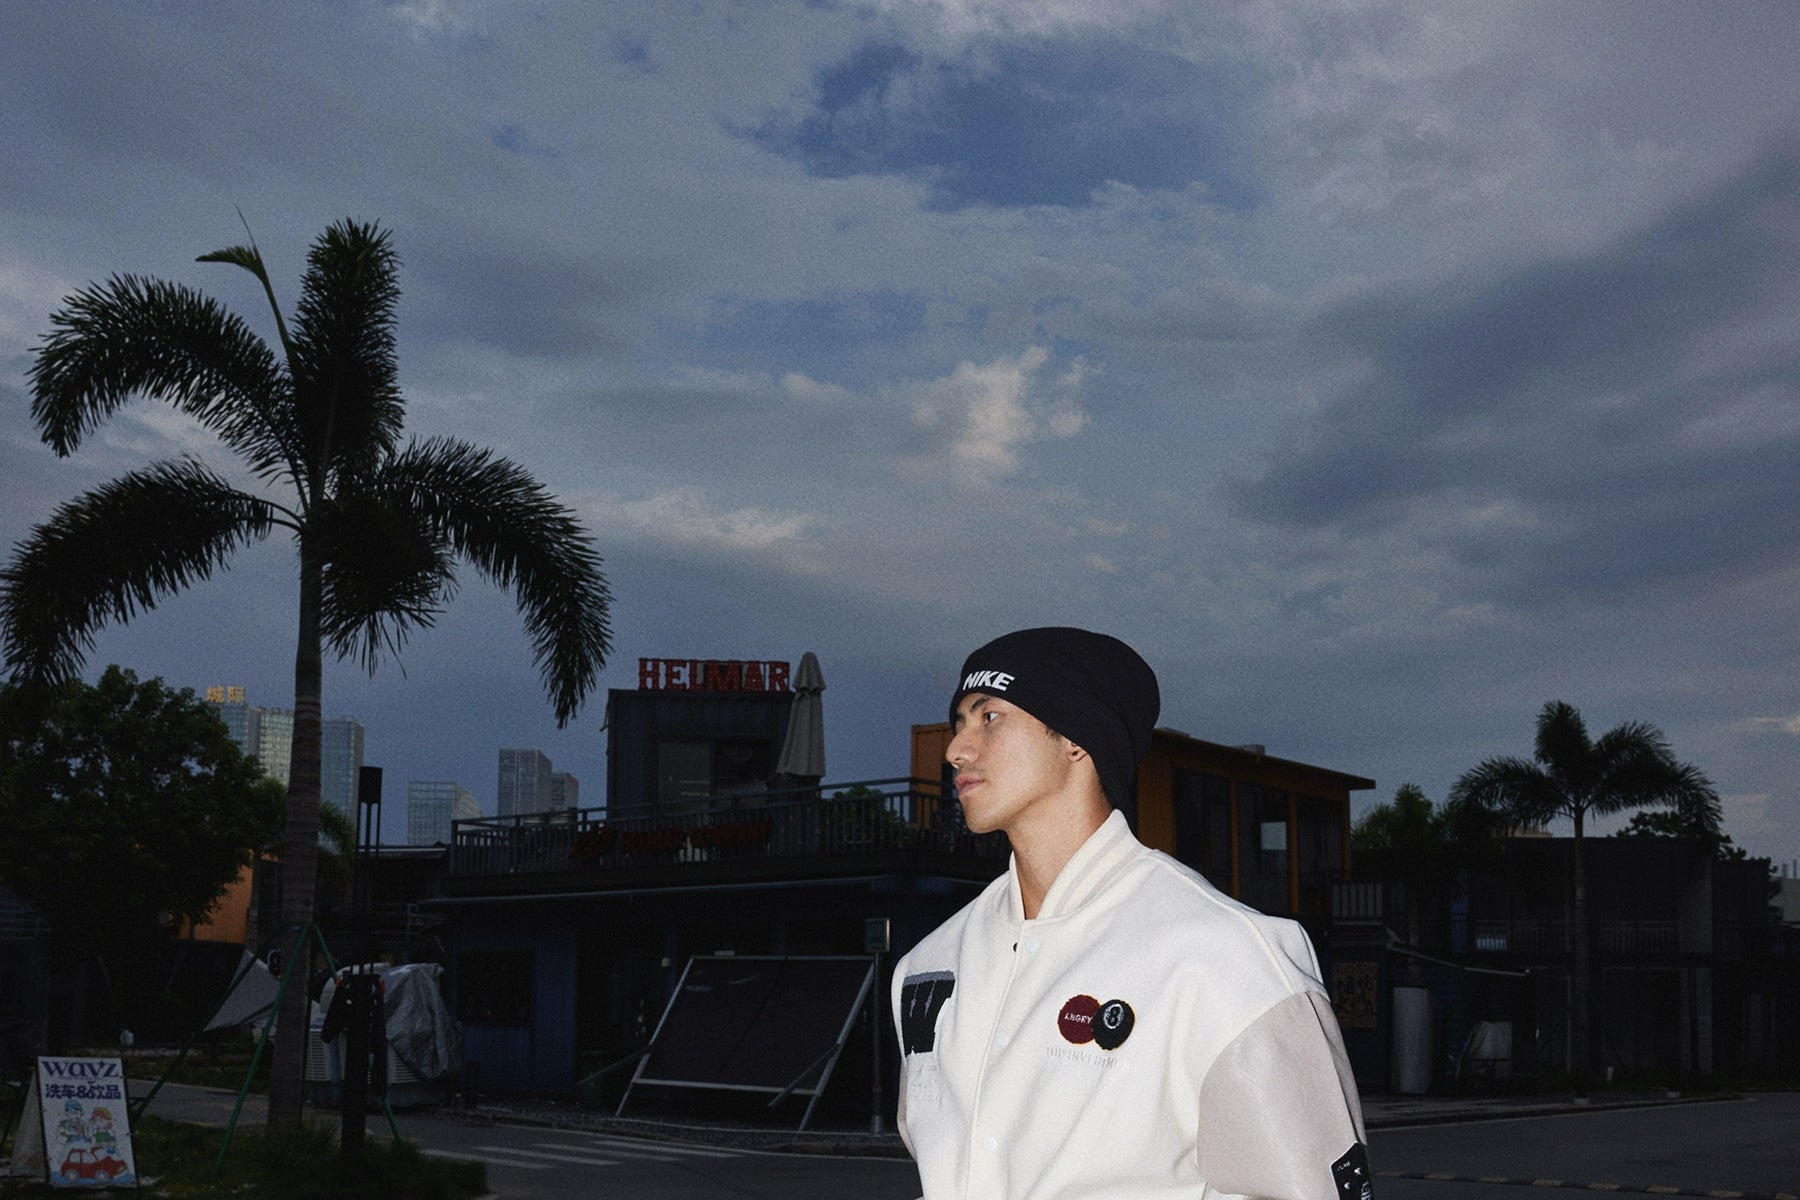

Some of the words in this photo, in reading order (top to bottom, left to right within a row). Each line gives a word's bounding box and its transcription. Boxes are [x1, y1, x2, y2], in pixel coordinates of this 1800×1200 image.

[638, 658, 790, 693] HELMAR
[962, 670, 1016, 692] NIKE
[1064, 1011, 1094, 1025] ANGRY
